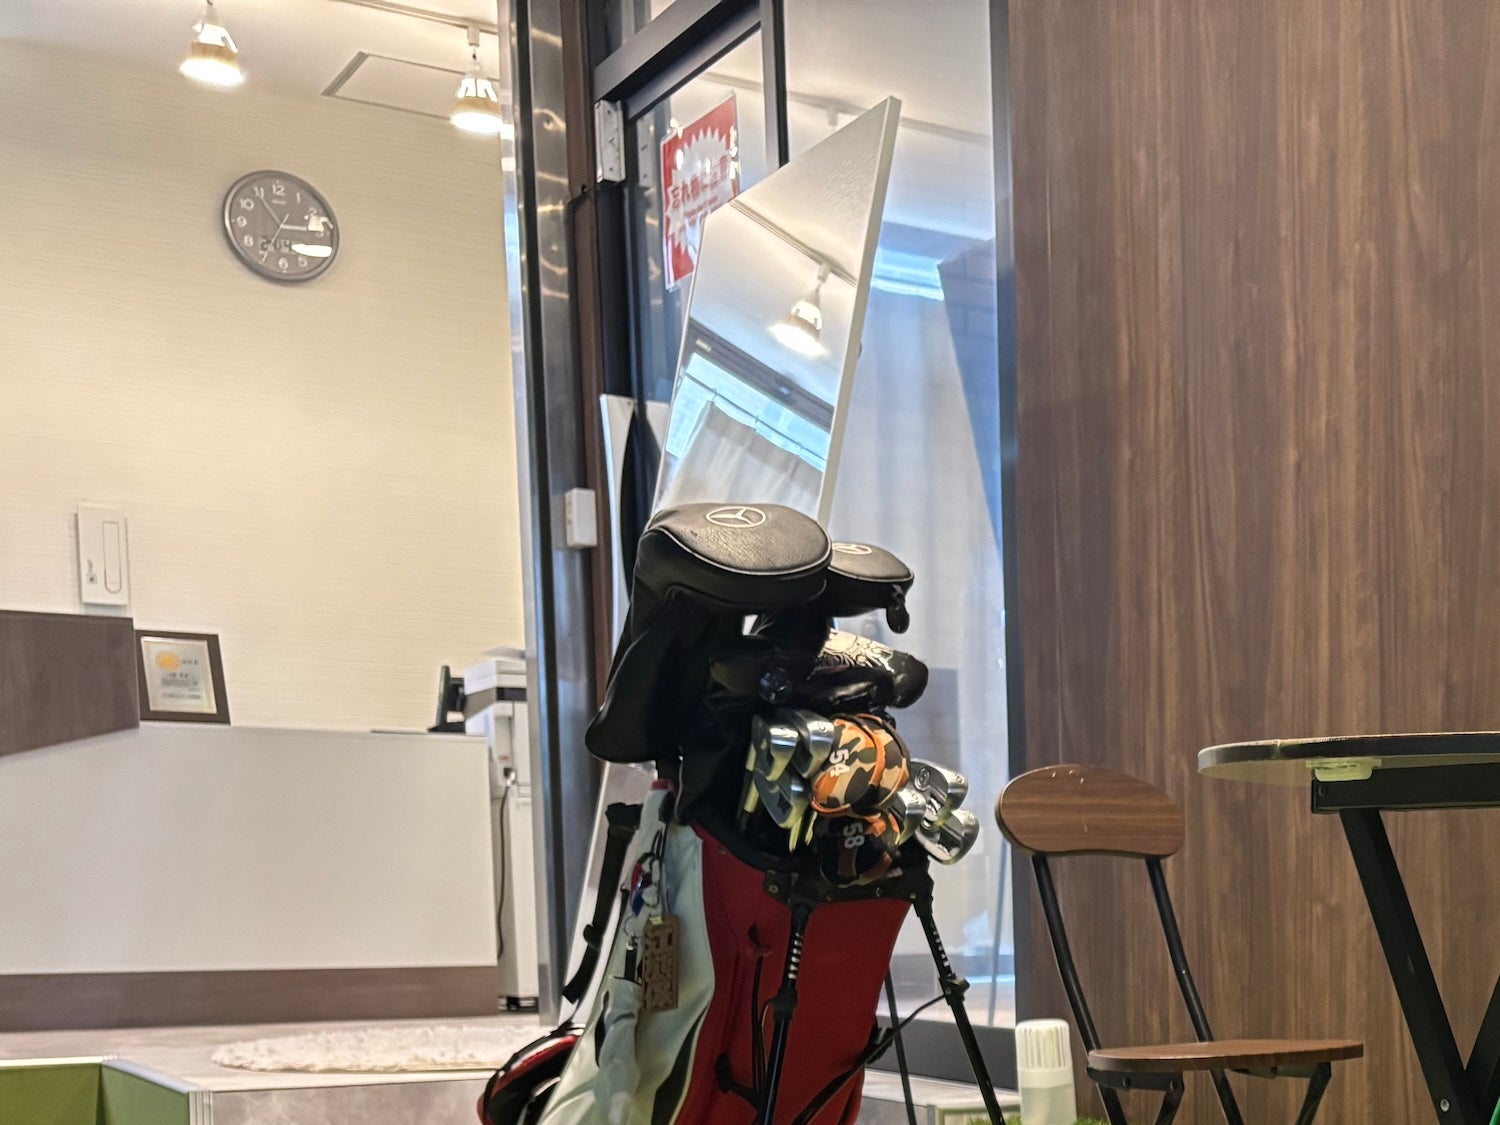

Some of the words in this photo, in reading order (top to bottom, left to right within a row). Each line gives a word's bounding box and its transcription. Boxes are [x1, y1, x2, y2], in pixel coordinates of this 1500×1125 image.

[272, 183, 286, 197] 12
[829, 748, 851, 778] 54
[843, 822, 866, 849] 58
